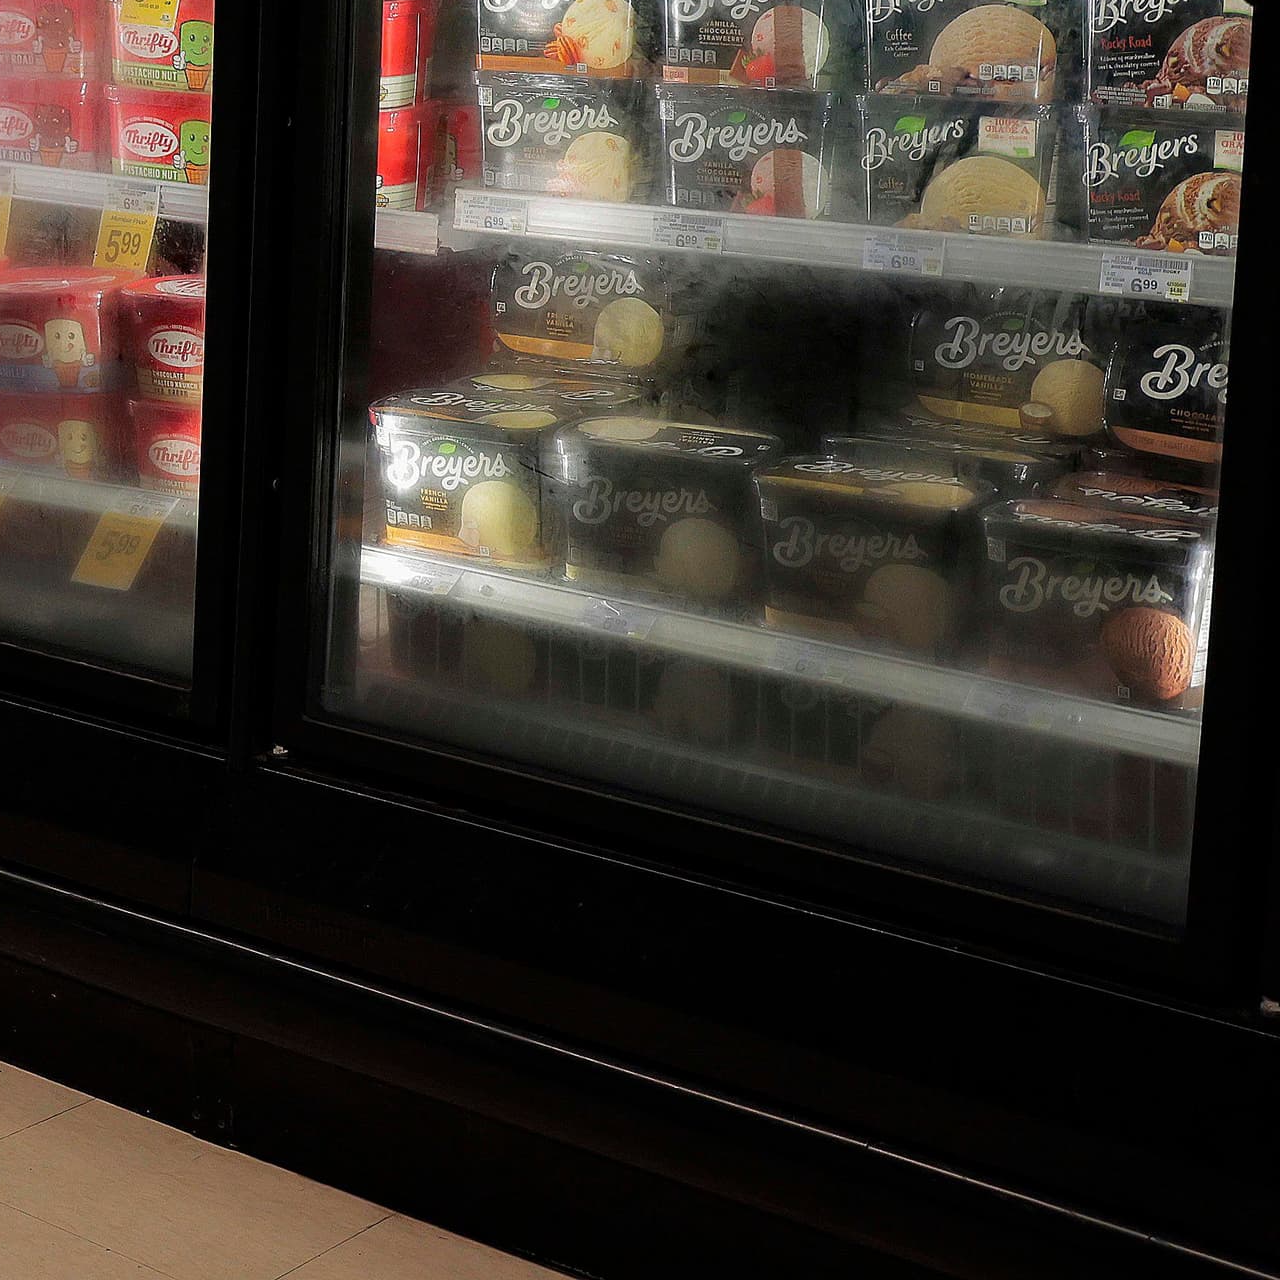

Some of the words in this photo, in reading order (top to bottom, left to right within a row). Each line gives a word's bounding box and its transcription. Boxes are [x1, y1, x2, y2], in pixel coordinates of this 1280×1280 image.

[124, 29, 174, 53] Thrifty
[886, 30, 912, 41] Coffee
[1101, 37, 1126, 50] Rocky
[1129, 35, 1152, 47] Road
[13, 54, 34, 64] ROAD
[162, 70, 177, 81] NUT
[1209, 78, 1220, 86] 170
[488, 99, 619, 147] Breyers
[126, 131, 175, 152] Thrifty
[669, 113, 808, 162] Breyers
[861, 119, 964, 170] Breyers
[9, 150, 31, 161] ROAD
[1082, 133, 1198, 186] Breyers
[161, 168, 178, 180] NUT
[515, 262, 645, 309] Breyers
[546, 320, 574, 328] VANILLA
[935, 316, 1091, 369] Breyers
[153, 380, 174, 388] MALTED
[175, 381, 198, 390] KRUNCH
[964, 373, 1013, 383] HOMEMADE
[411, 392, 553, 412] Breyers
[387, 440, 512, 490] Breyers
[795, 460, 964, 485] Breyers
[420, 496, 448, 505] VANILLA
[421, 488, 447, 497] FRENCH
[573, 475, 718, 524] Breyers
[773, 519, 927, 567] Breyers
[1000, 556, 1173, 616] Breyers
